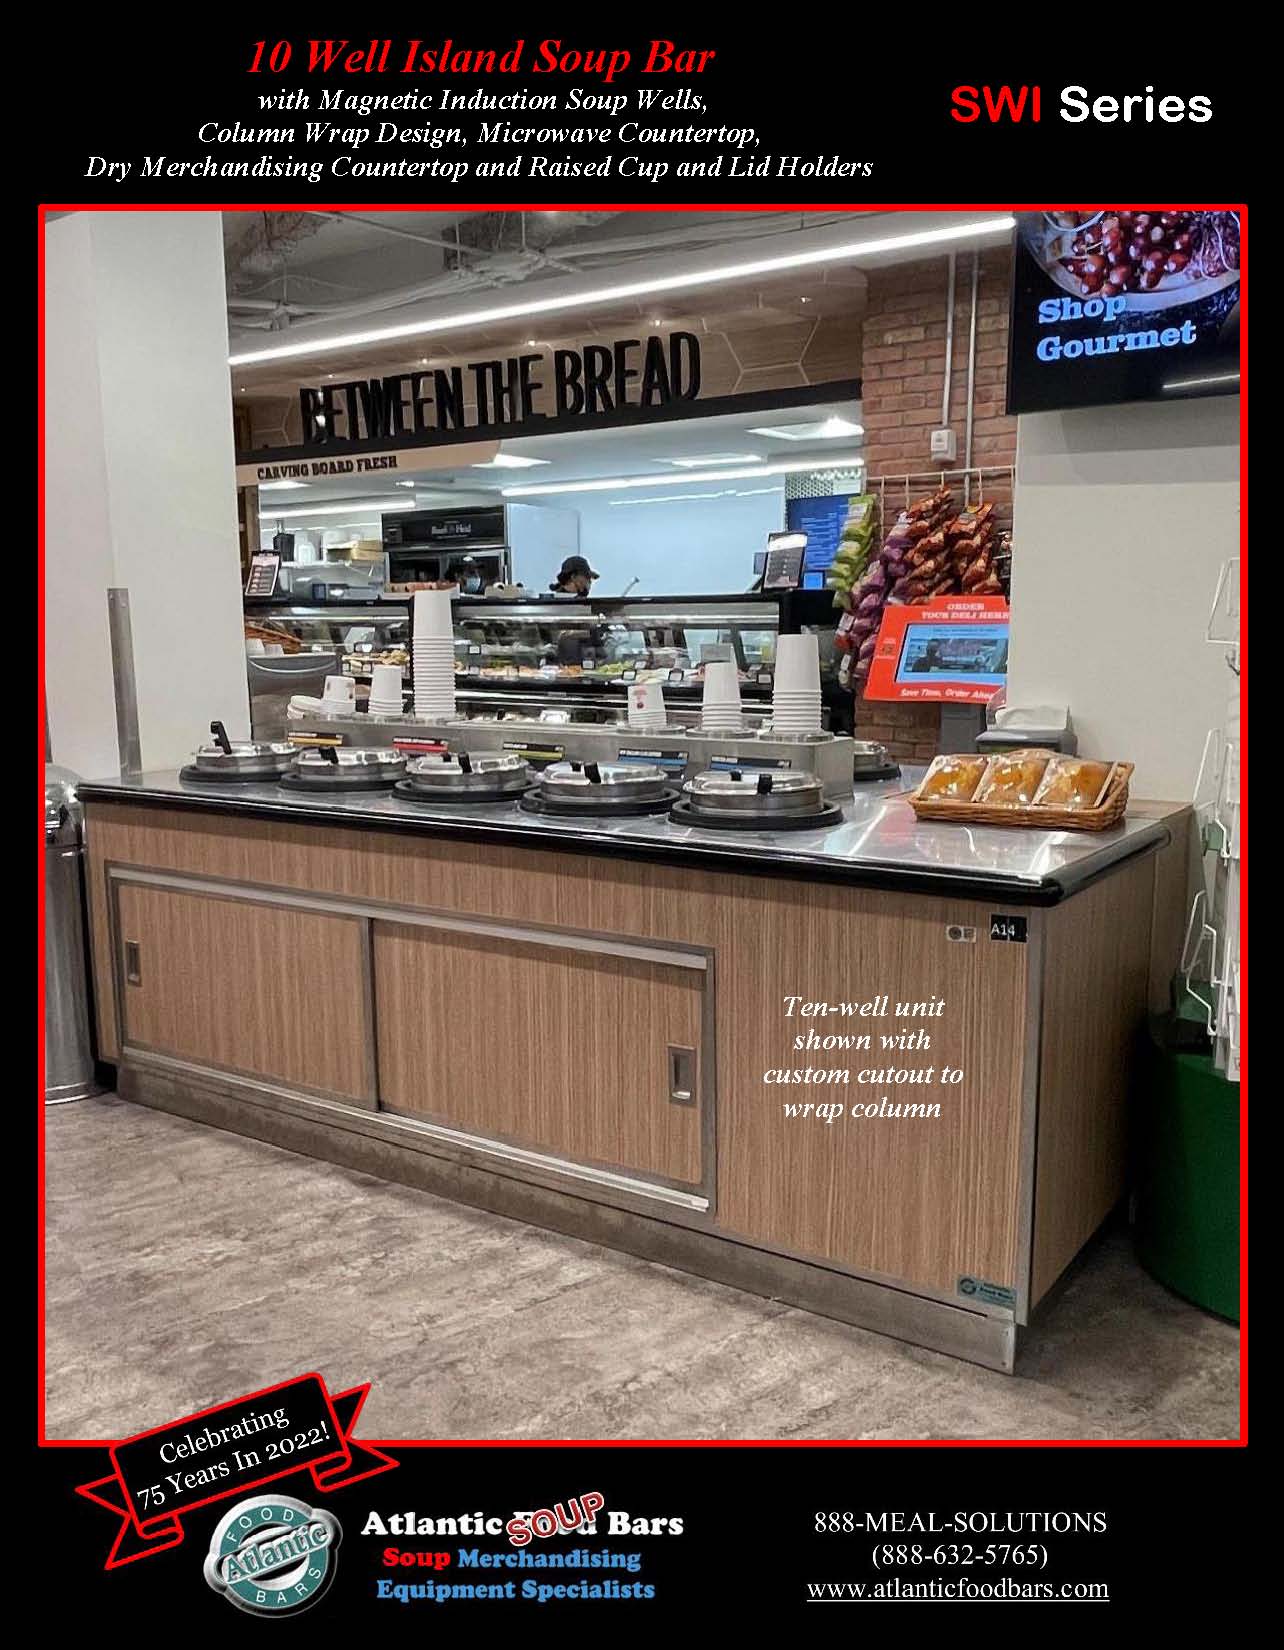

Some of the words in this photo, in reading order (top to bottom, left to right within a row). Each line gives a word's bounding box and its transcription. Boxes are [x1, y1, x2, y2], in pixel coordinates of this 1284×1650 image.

[1038, 296, 1126, 324] Shop
[1037, 319, 1197, 361] Gourmet
[299, 366, 464, 444] BETWEEN
[468, 354, 546, 424] THE
[554, 331, 701, 415] BREAD
[257, 461, 309, 480] CARVING
[312, 459, 354, 476] BOARD
[357, 456, 398, 472] FRESH
[991, 923, 1016, 936] A14
